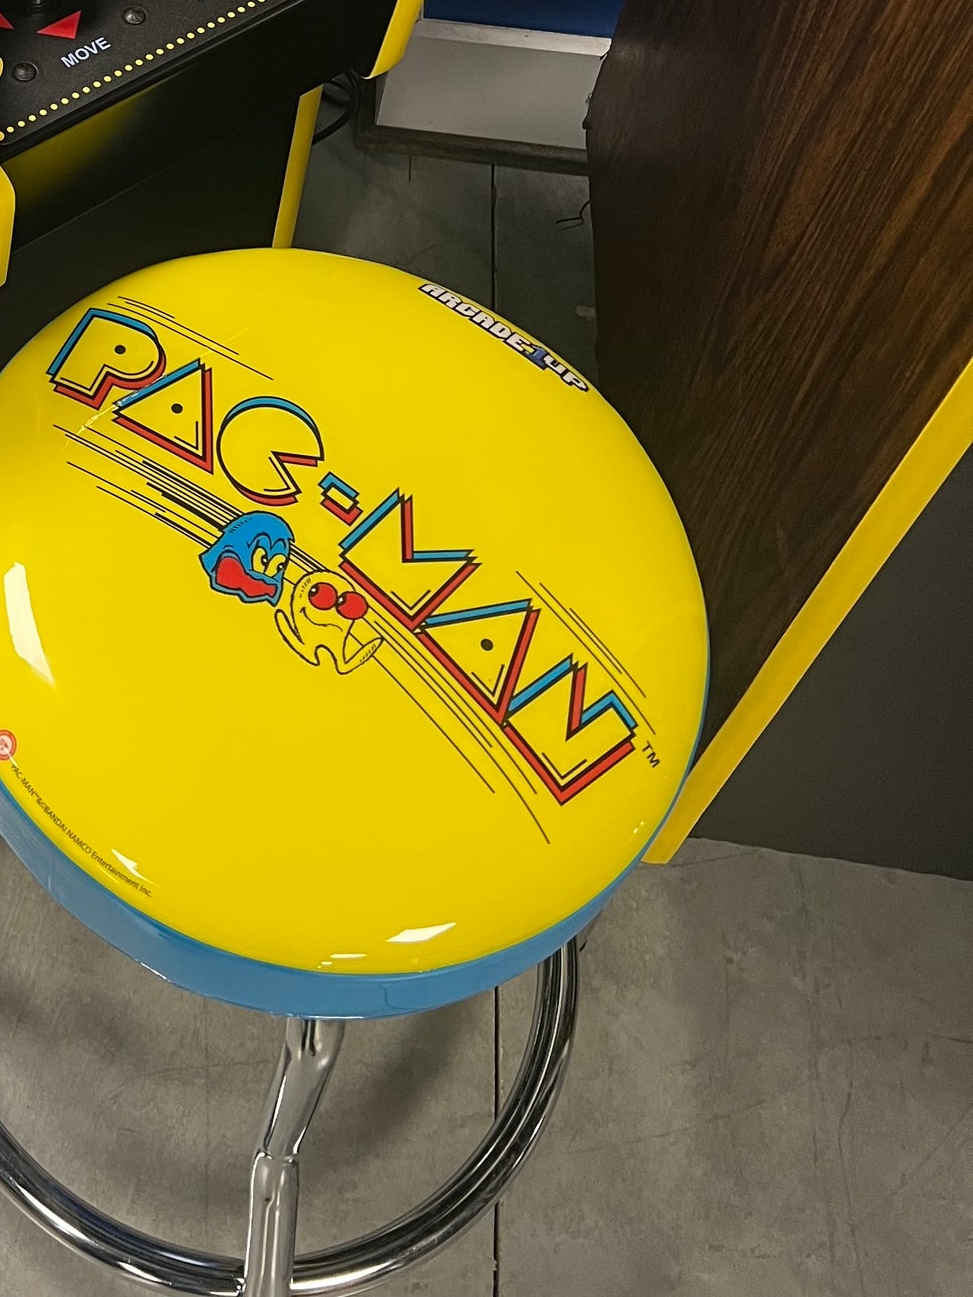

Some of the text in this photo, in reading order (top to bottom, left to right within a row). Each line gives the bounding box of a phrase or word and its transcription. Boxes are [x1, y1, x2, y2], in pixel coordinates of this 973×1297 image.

[60, 36, 111, 68] MOVE
[47, 308, 639, 806] PAC-MAN
[66, 828, 92, 855] NAMCO
[91, 852, 139, 890] Entertainment
